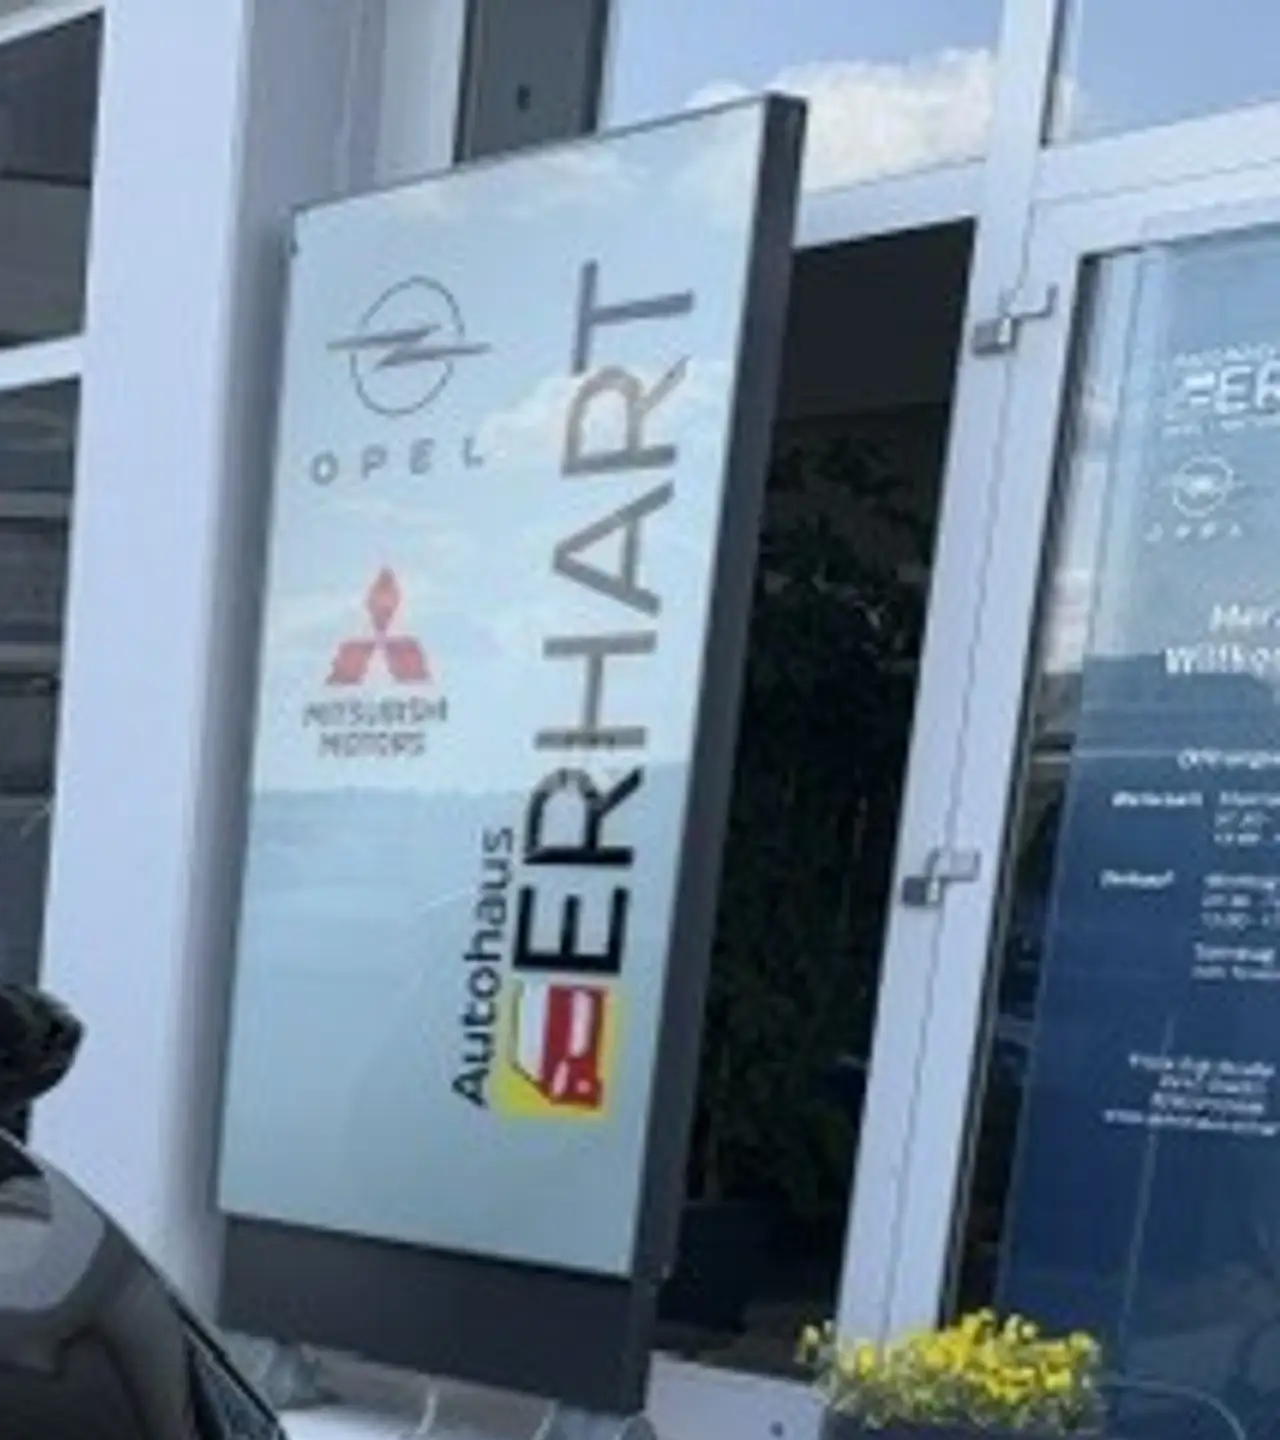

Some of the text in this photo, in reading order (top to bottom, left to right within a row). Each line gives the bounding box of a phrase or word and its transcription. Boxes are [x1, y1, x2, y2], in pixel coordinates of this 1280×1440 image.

[309, 437, 485, 486] OPEL
[513, 259, 695, 976] ERHART
[318, 731, 426, 758] MOTORS
[451, 825, 515, 1110] Autohaus
